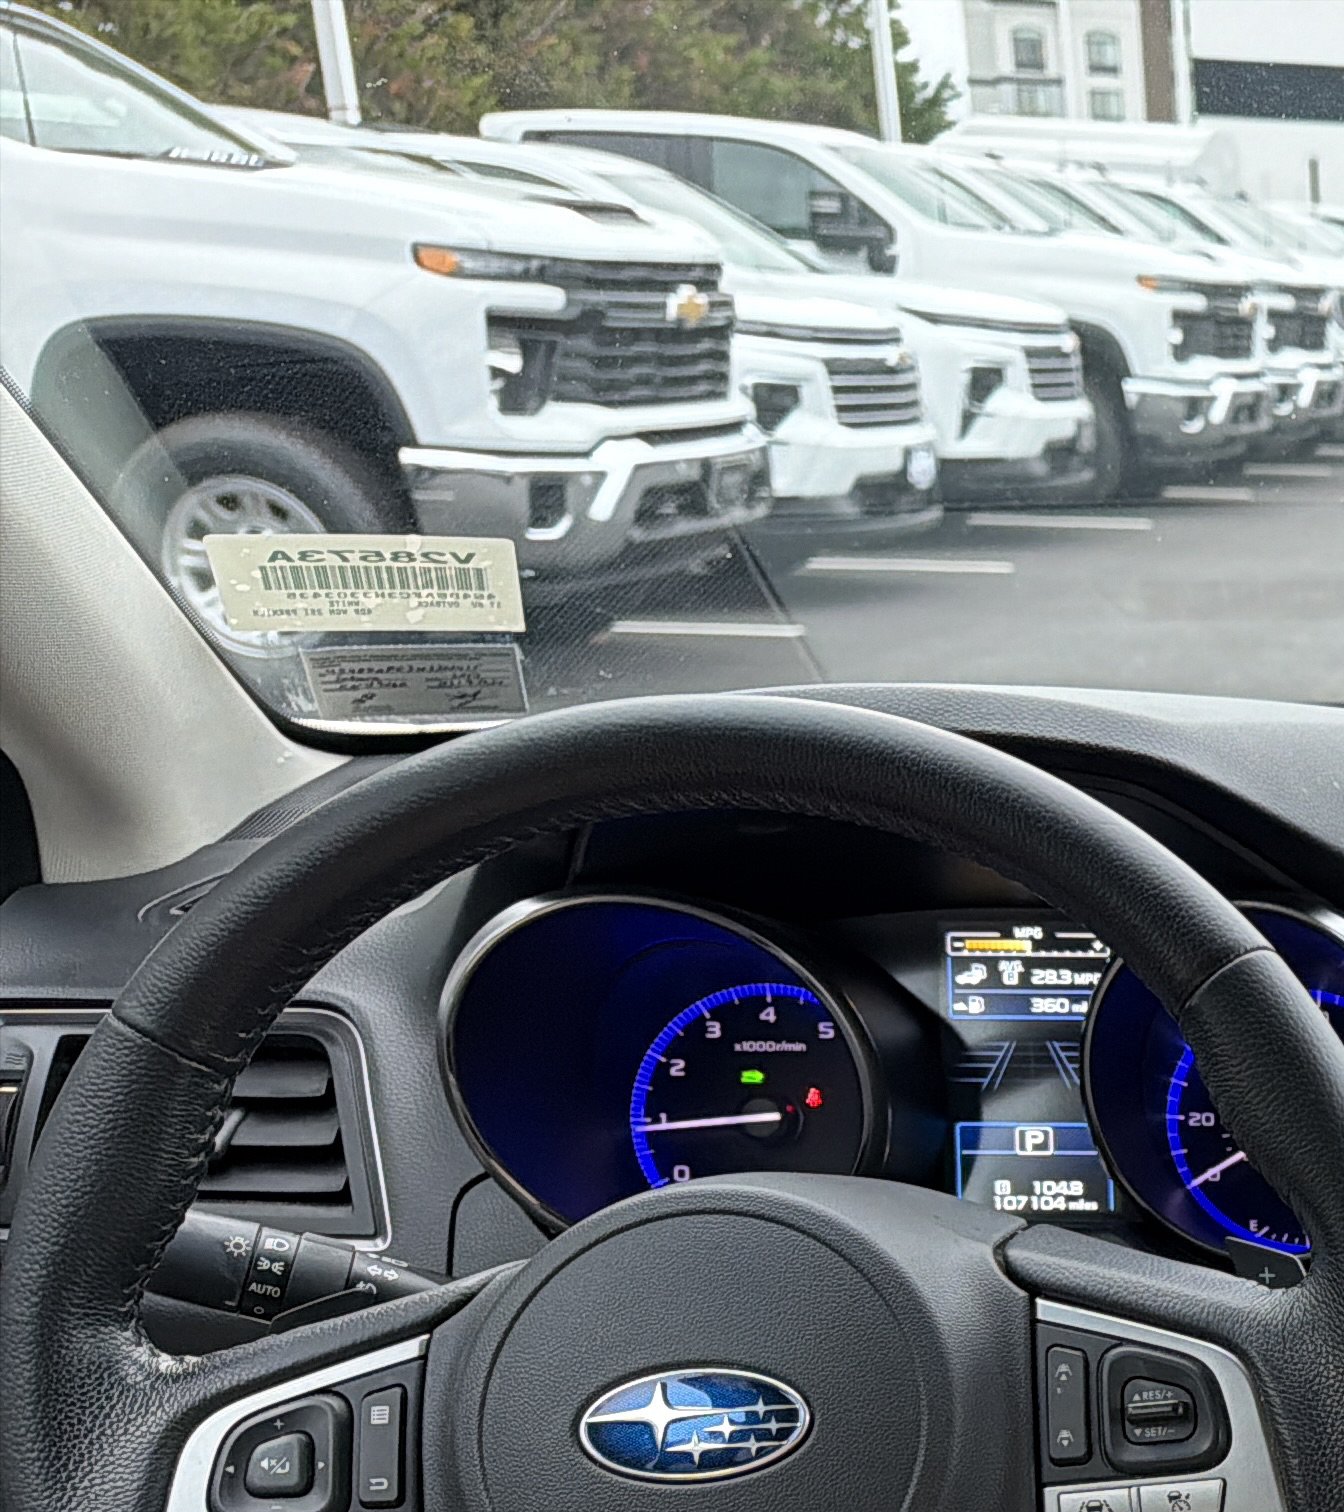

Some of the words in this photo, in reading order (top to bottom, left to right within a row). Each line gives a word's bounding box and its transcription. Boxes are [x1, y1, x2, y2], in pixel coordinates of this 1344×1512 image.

[1013, 926, 1043, 939] MPG
[1030, 997, 1069, 1013] 360
[759, 1006, 776, 1023] 4
[705, 1021, 721, 1038] 3
[817, 1021, 835, 1039] 5
[669, 1059, 686, 1076] 2
[1189, 1112, 1215, 1126] 20
[1024, 1130, 1045, 1153] P
[673, 1165, 690, 1181] 0
[1068, 1199, 1099, 1210] miles
[1249, 1219, 1259, 1232] E
[248, 1281, 281, 1298] AUTO
